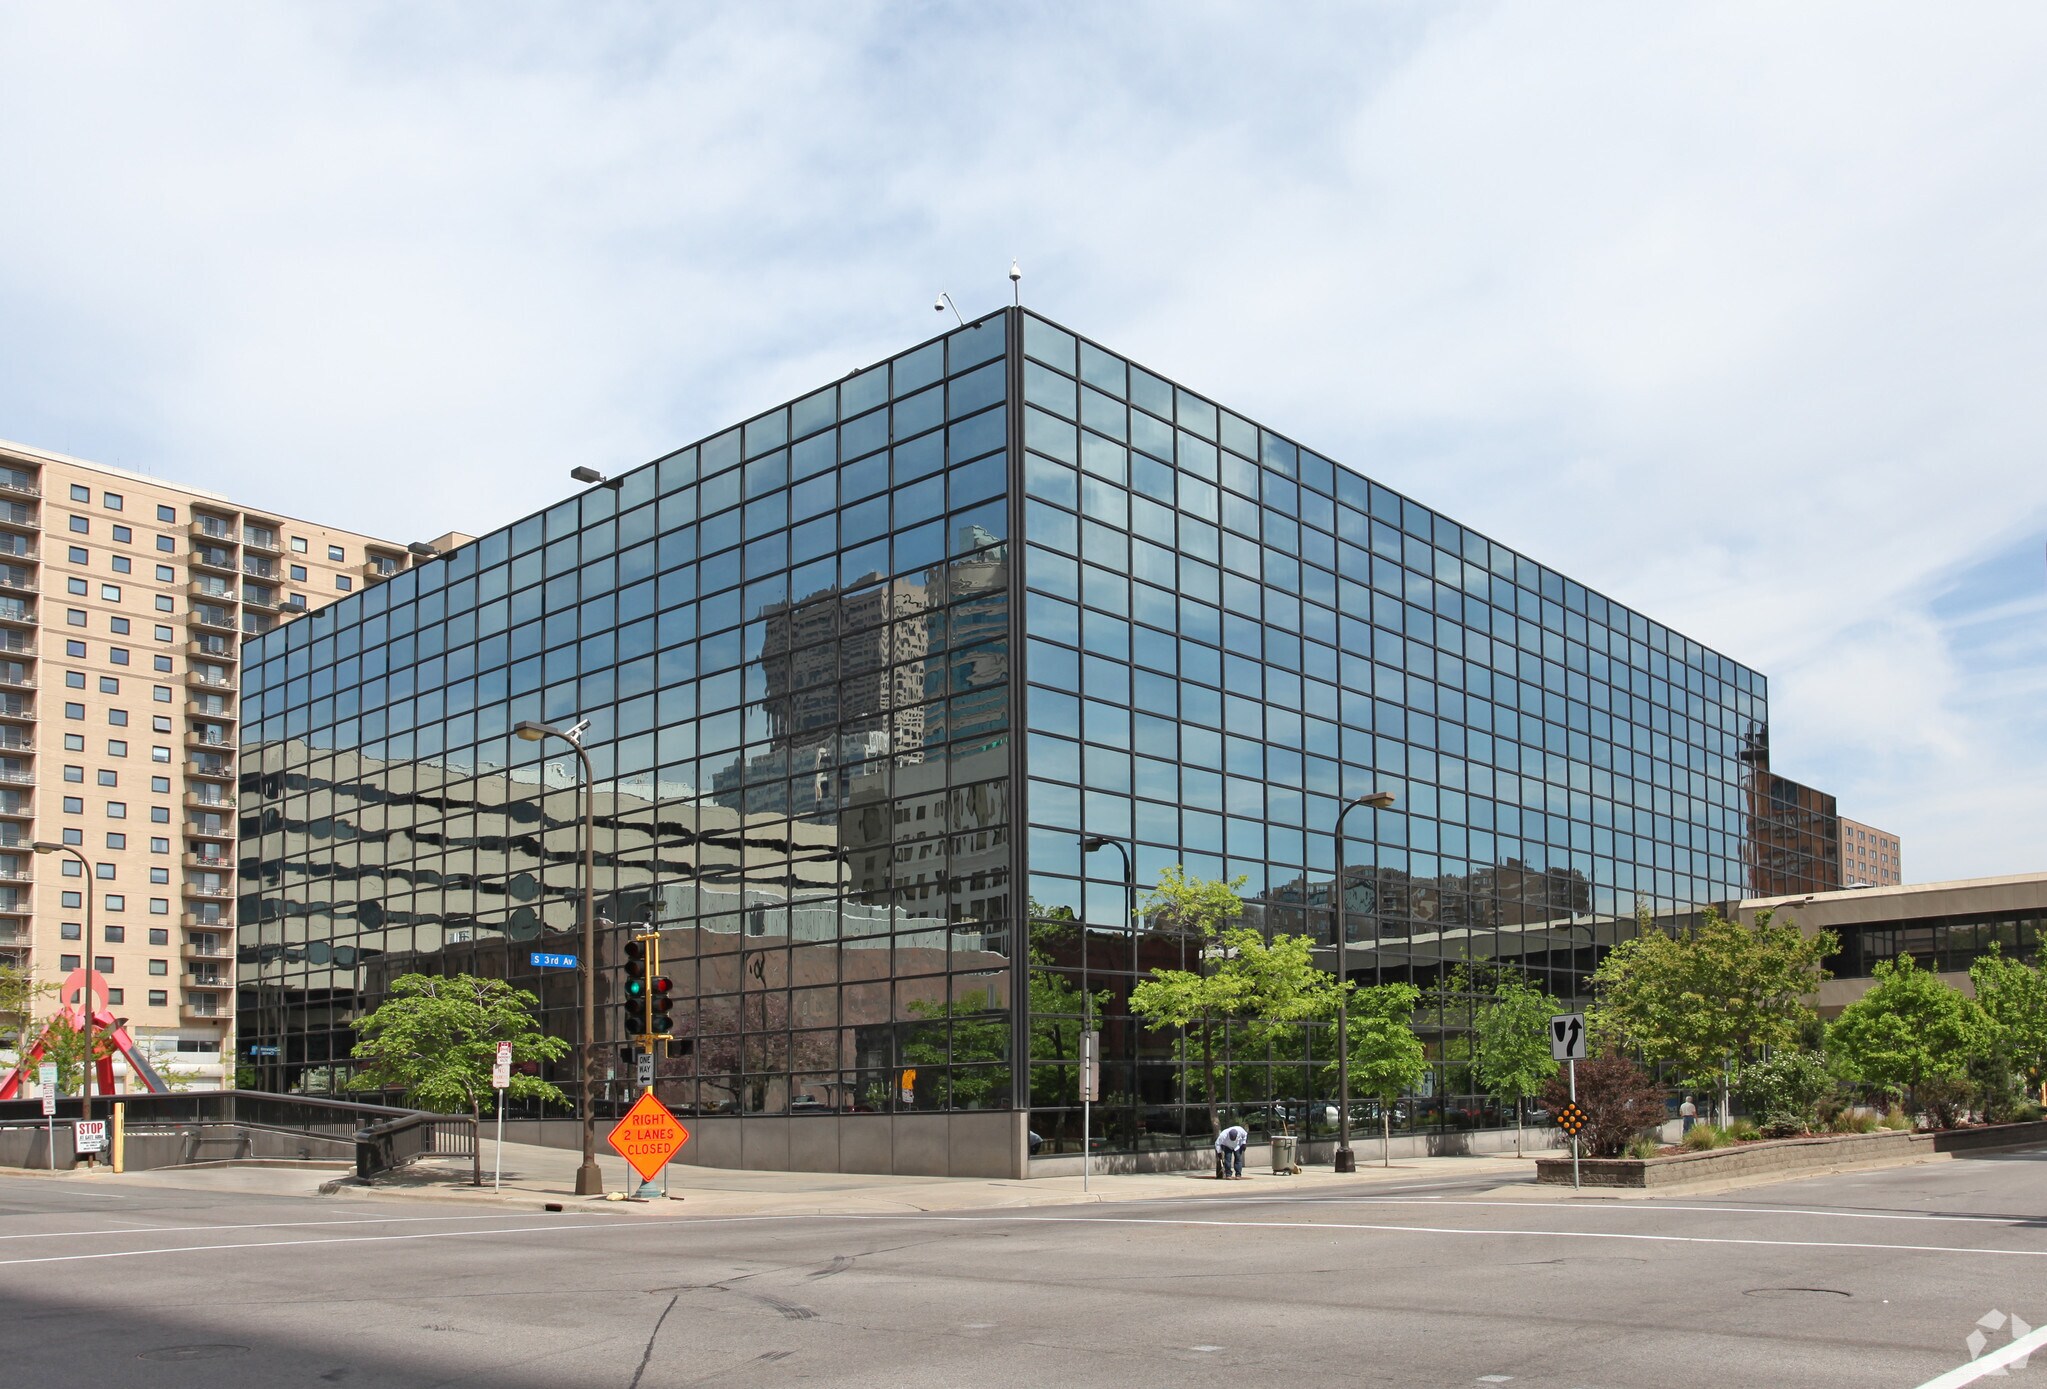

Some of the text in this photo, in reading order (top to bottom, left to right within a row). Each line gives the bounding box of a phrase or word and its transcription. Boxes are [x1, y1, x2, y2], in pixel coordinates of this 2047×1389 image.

[534, 955, 573, 965] S 3rd Av
[640, 1056, 651, 1064] ONE
[640, 1065, 650, 1073] WAY
[633, 1114, 665, 1125] RIGHT
[79, 1123, 103, 1135] STOP
[624, 1129, 674, 1140] 2 LANES
[628, 1143, 671, 1155] CLOSED
